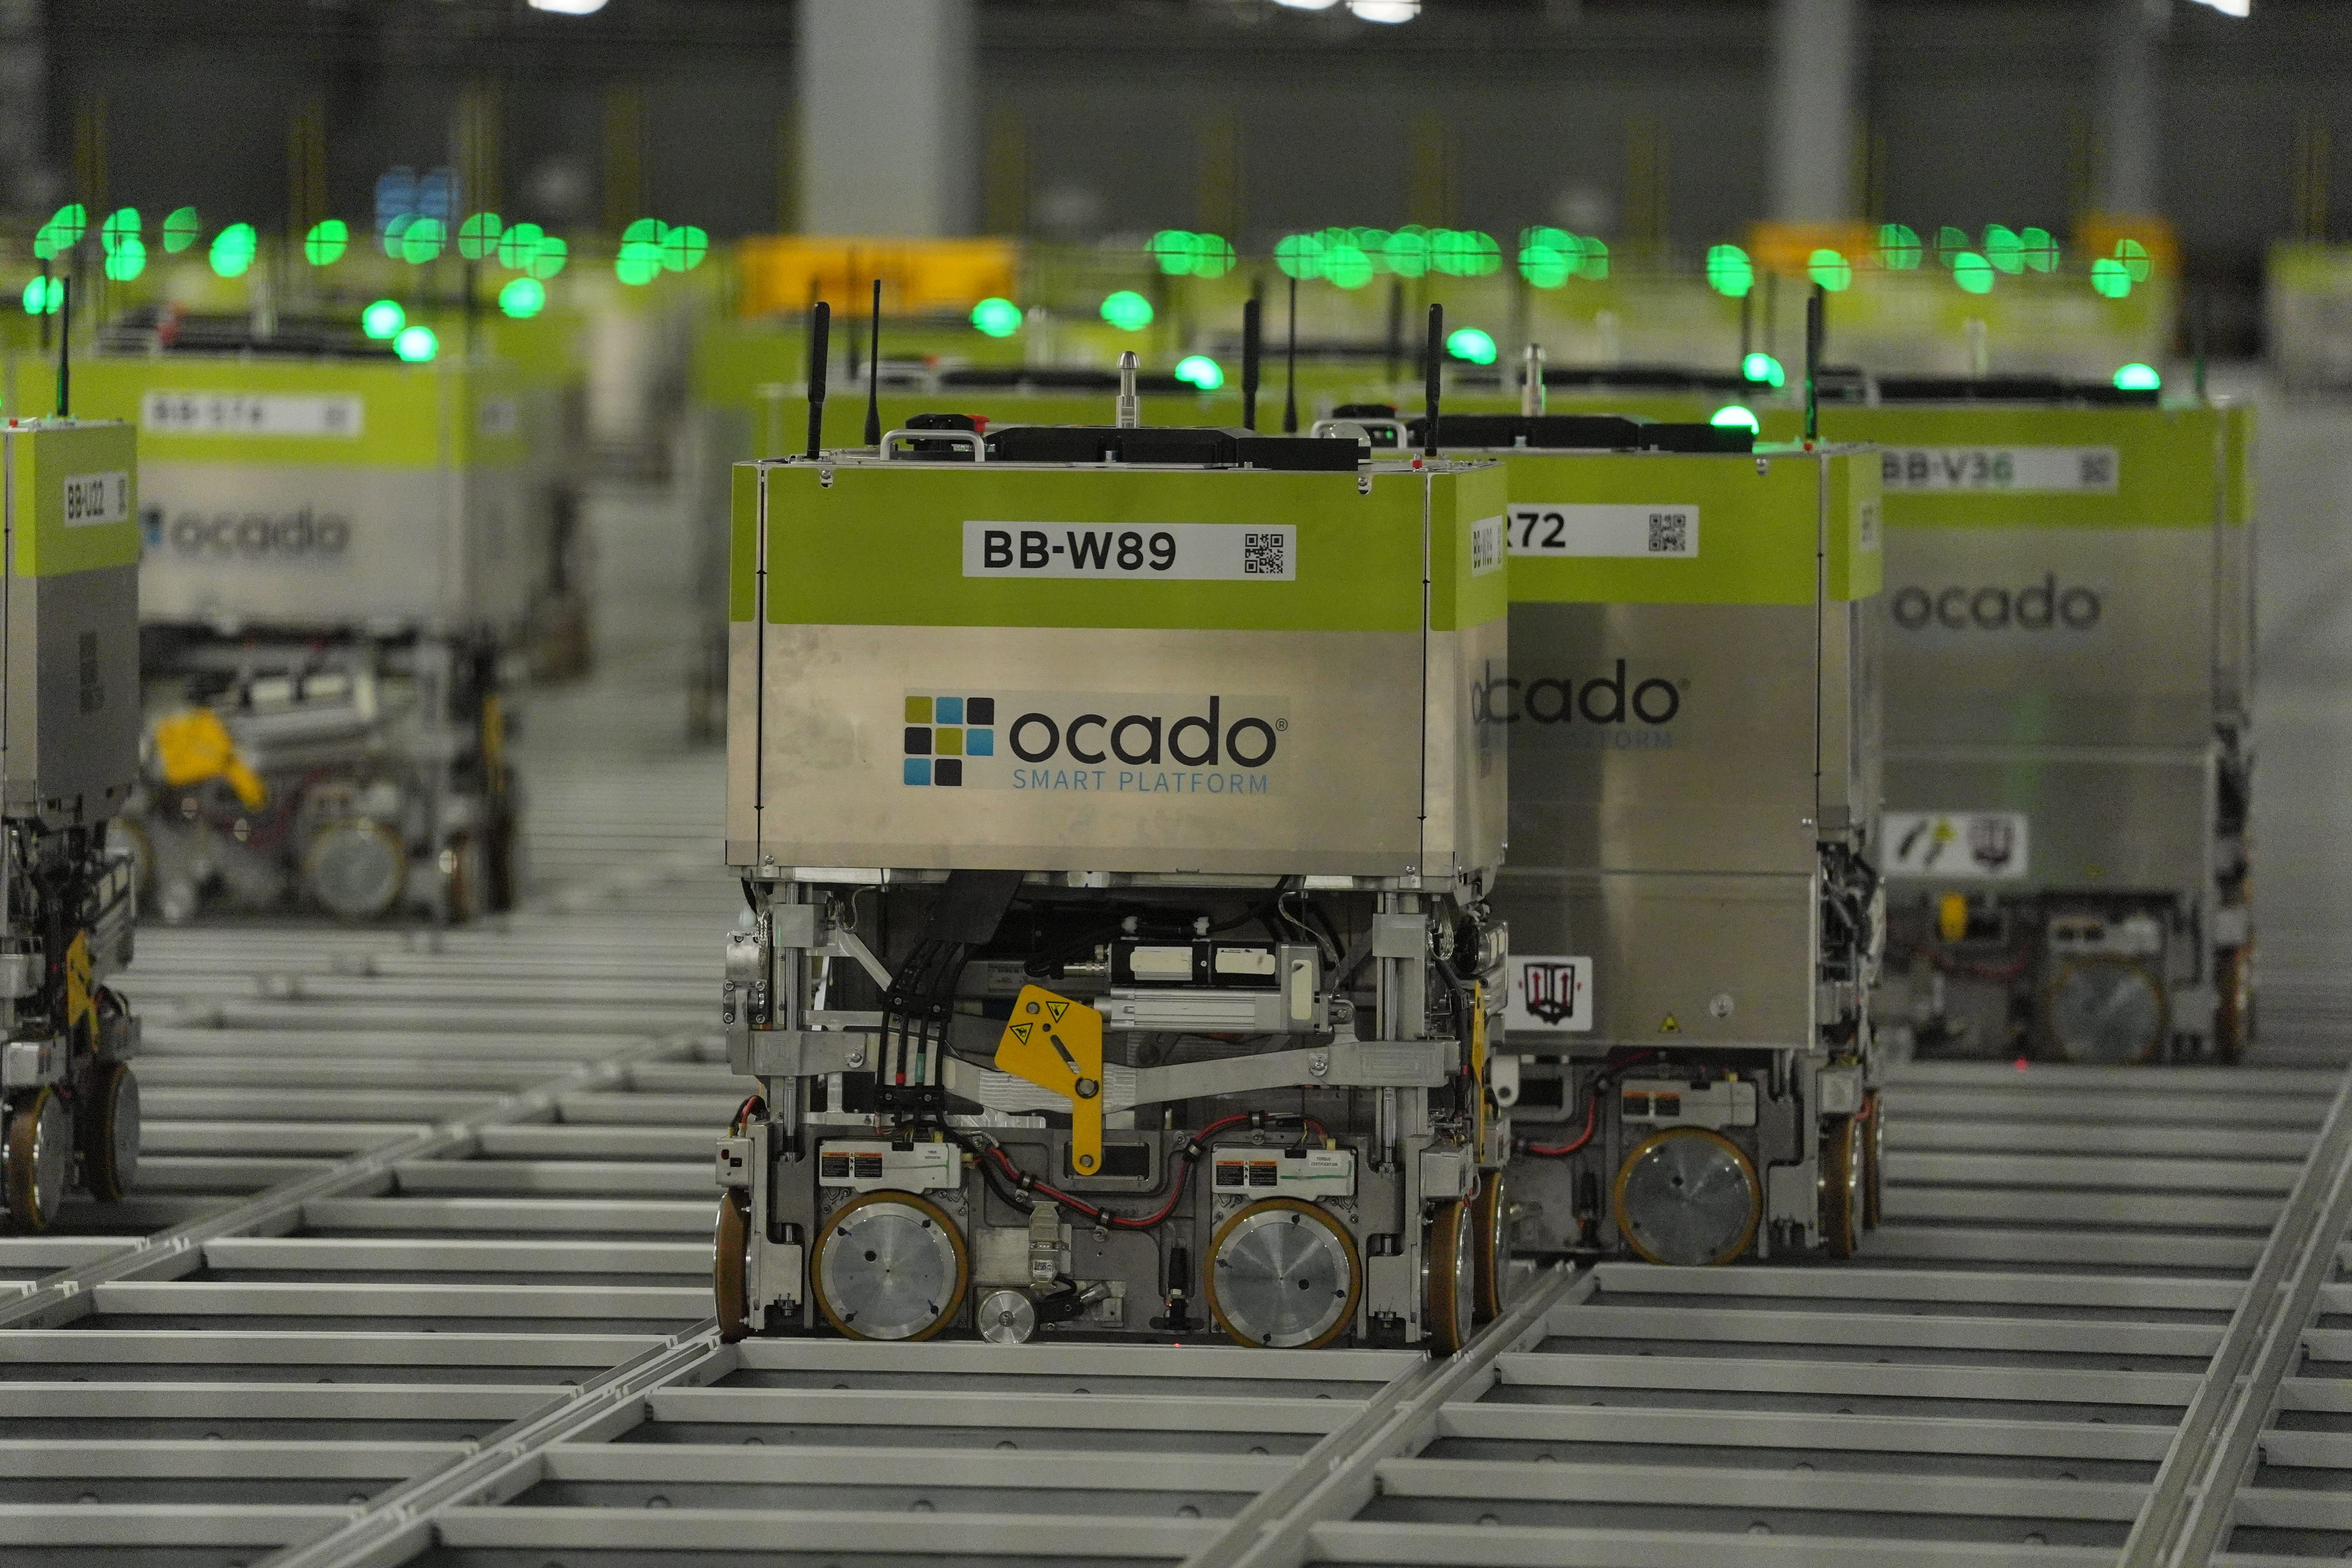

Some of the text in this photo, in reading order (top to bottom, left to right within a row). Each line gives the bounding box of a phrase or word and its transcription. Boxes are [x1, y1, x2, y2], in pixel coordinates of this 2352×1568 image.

[68, 479, 104, 519] BB-U22
[983, 531, 1178, 572] BB-W89
[1891, 570, 2103, 632] ocado
[1013, 769, 1269, 795] SMART PLATFORM
